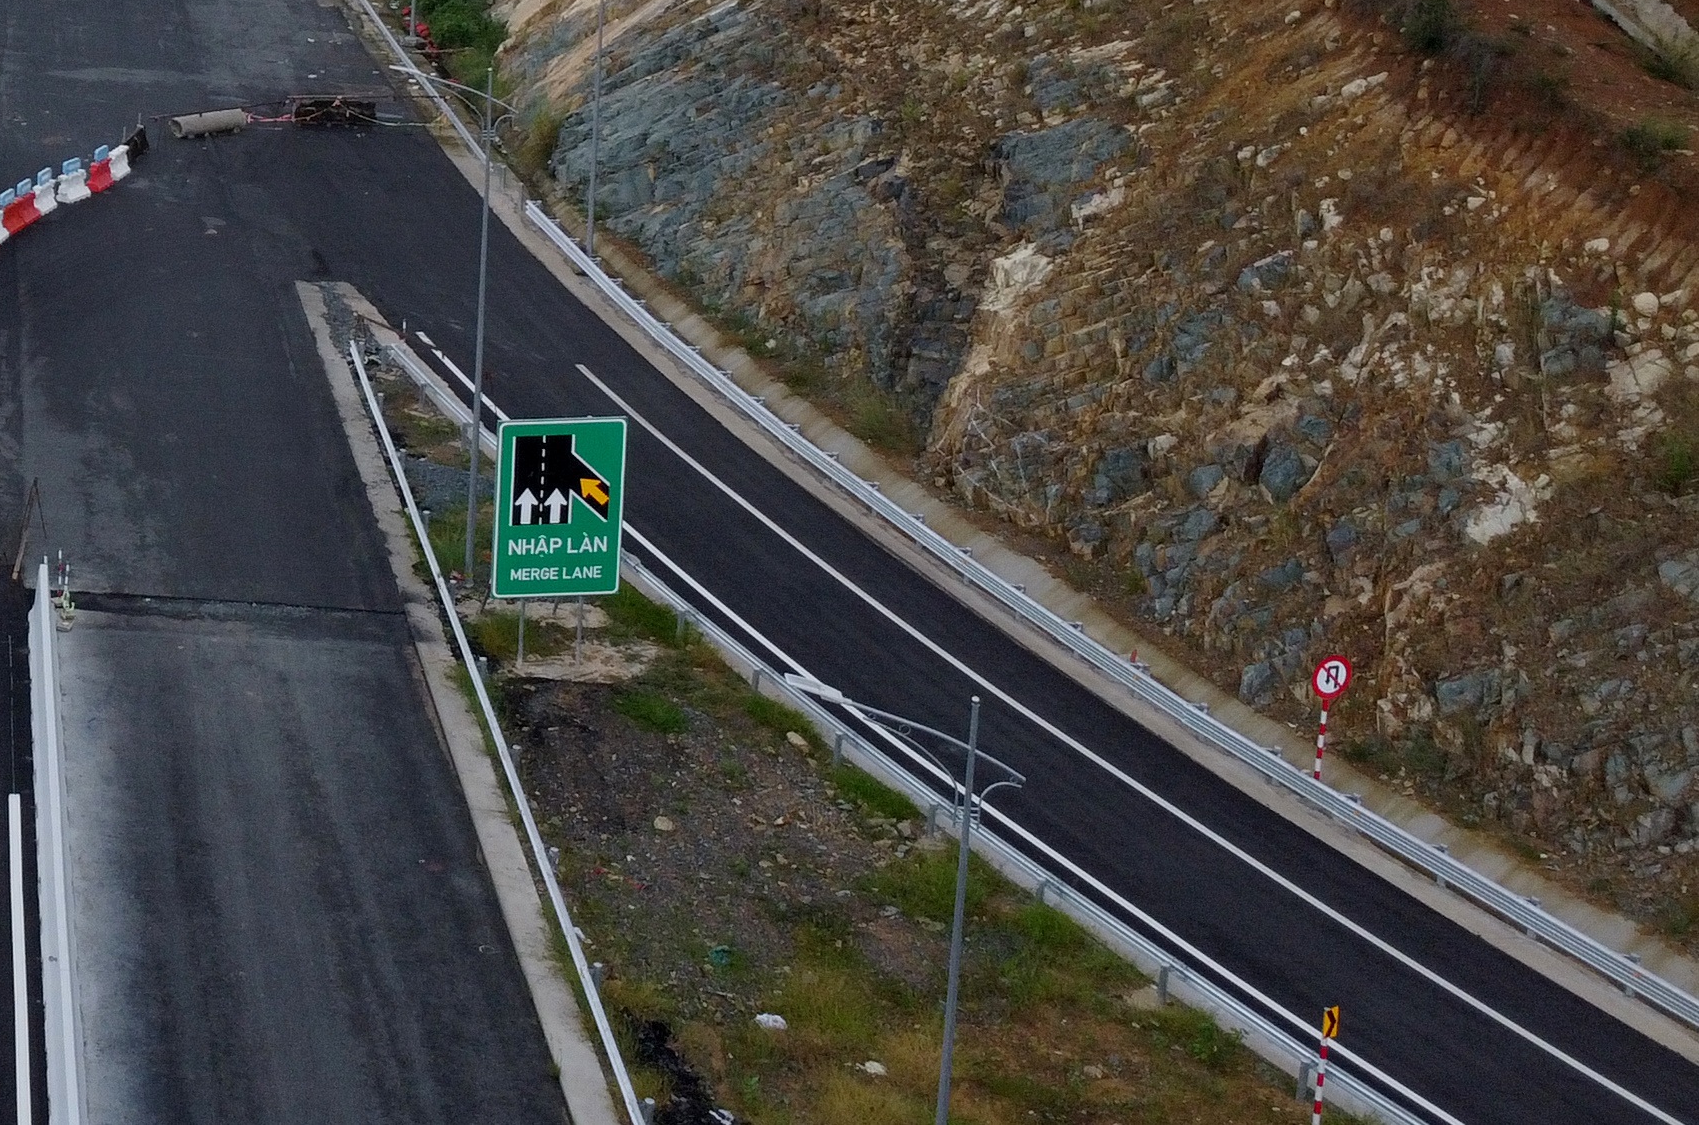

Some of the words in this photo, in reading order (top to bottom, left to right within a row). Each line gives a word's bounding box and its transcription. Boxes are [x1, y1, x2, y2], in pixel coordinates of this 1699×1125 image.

[508, 534, 562, 557] NHẬP
[567, 532, 608, 554] LÀN
[510, 567, 559, 581] MERGE
[562, 565, 602, 579] LANE
